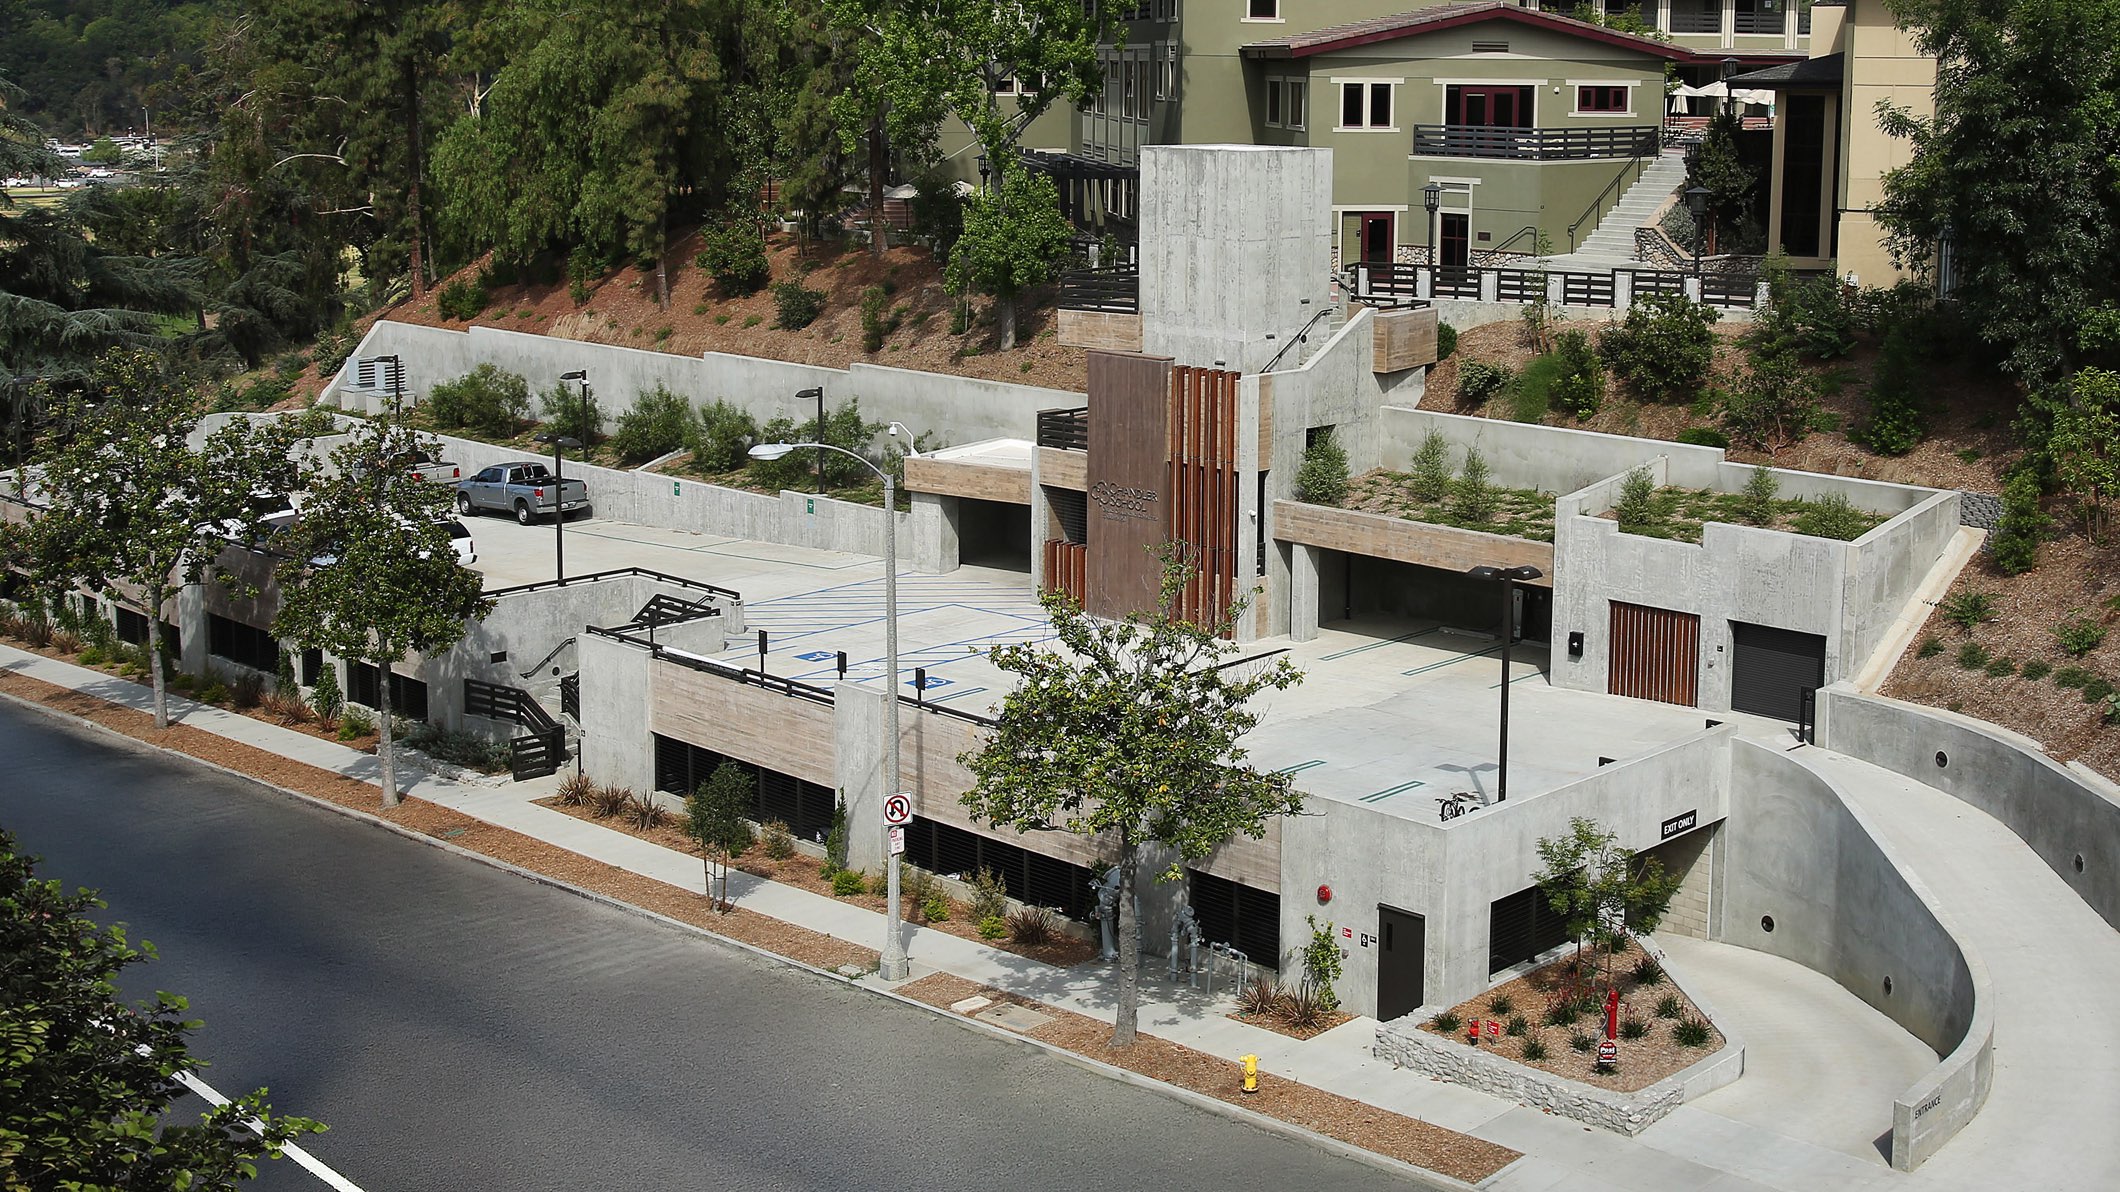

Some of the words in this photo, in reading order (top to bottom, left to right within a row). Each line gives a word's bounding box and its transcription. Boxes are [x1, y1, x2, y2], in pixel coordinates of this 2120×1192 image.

[1109, 483, 1158, 502] CHANDLER
[1109, 496, 1147, 513] SCHOOL
[1664, 821, 1678, 835] EXIT
[1678, 815, 1695, 829] ONLY
[1914, 1094, 1941, 1119] ENTRANCE
